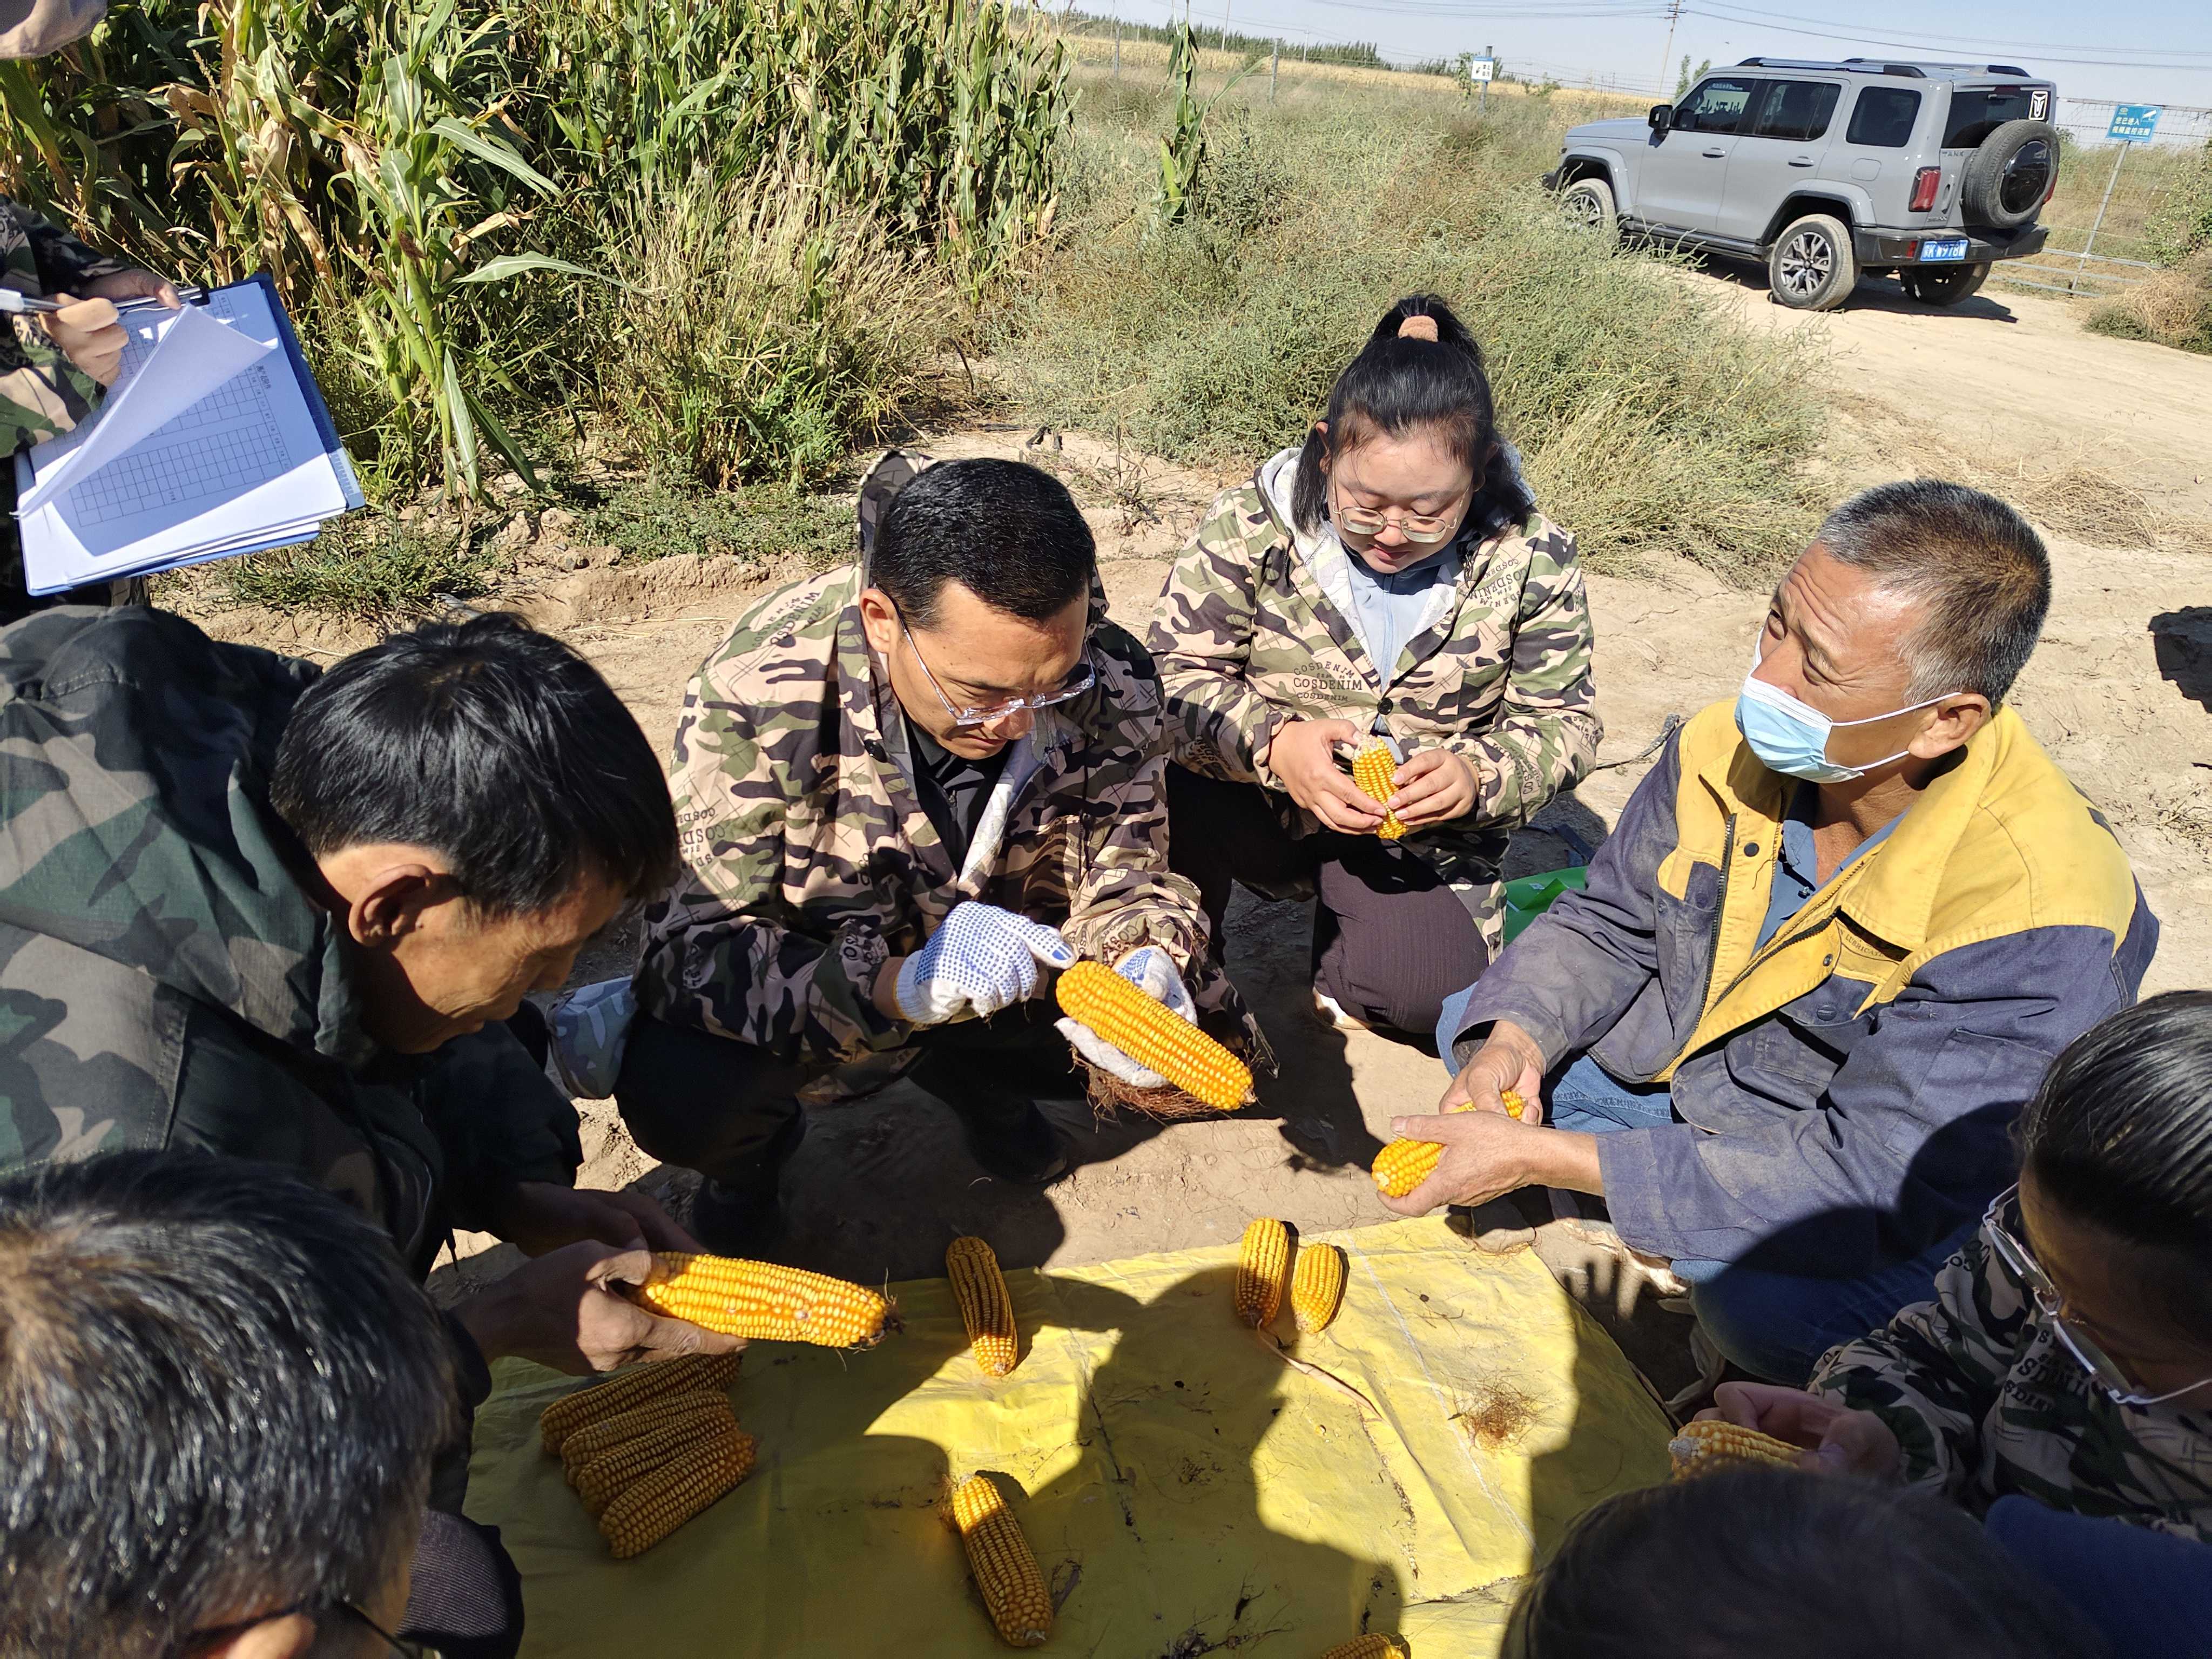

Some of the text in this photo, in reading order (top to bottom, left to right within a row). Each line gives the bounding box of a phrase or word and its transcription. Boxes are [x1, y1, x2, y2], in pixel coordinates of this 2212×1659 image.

[1293, 660, 1355, 679] COSDENIM
[1293, 677, 1363, 691] COSDENIM
[1297, 692, 1348, 702] COSDENIM
